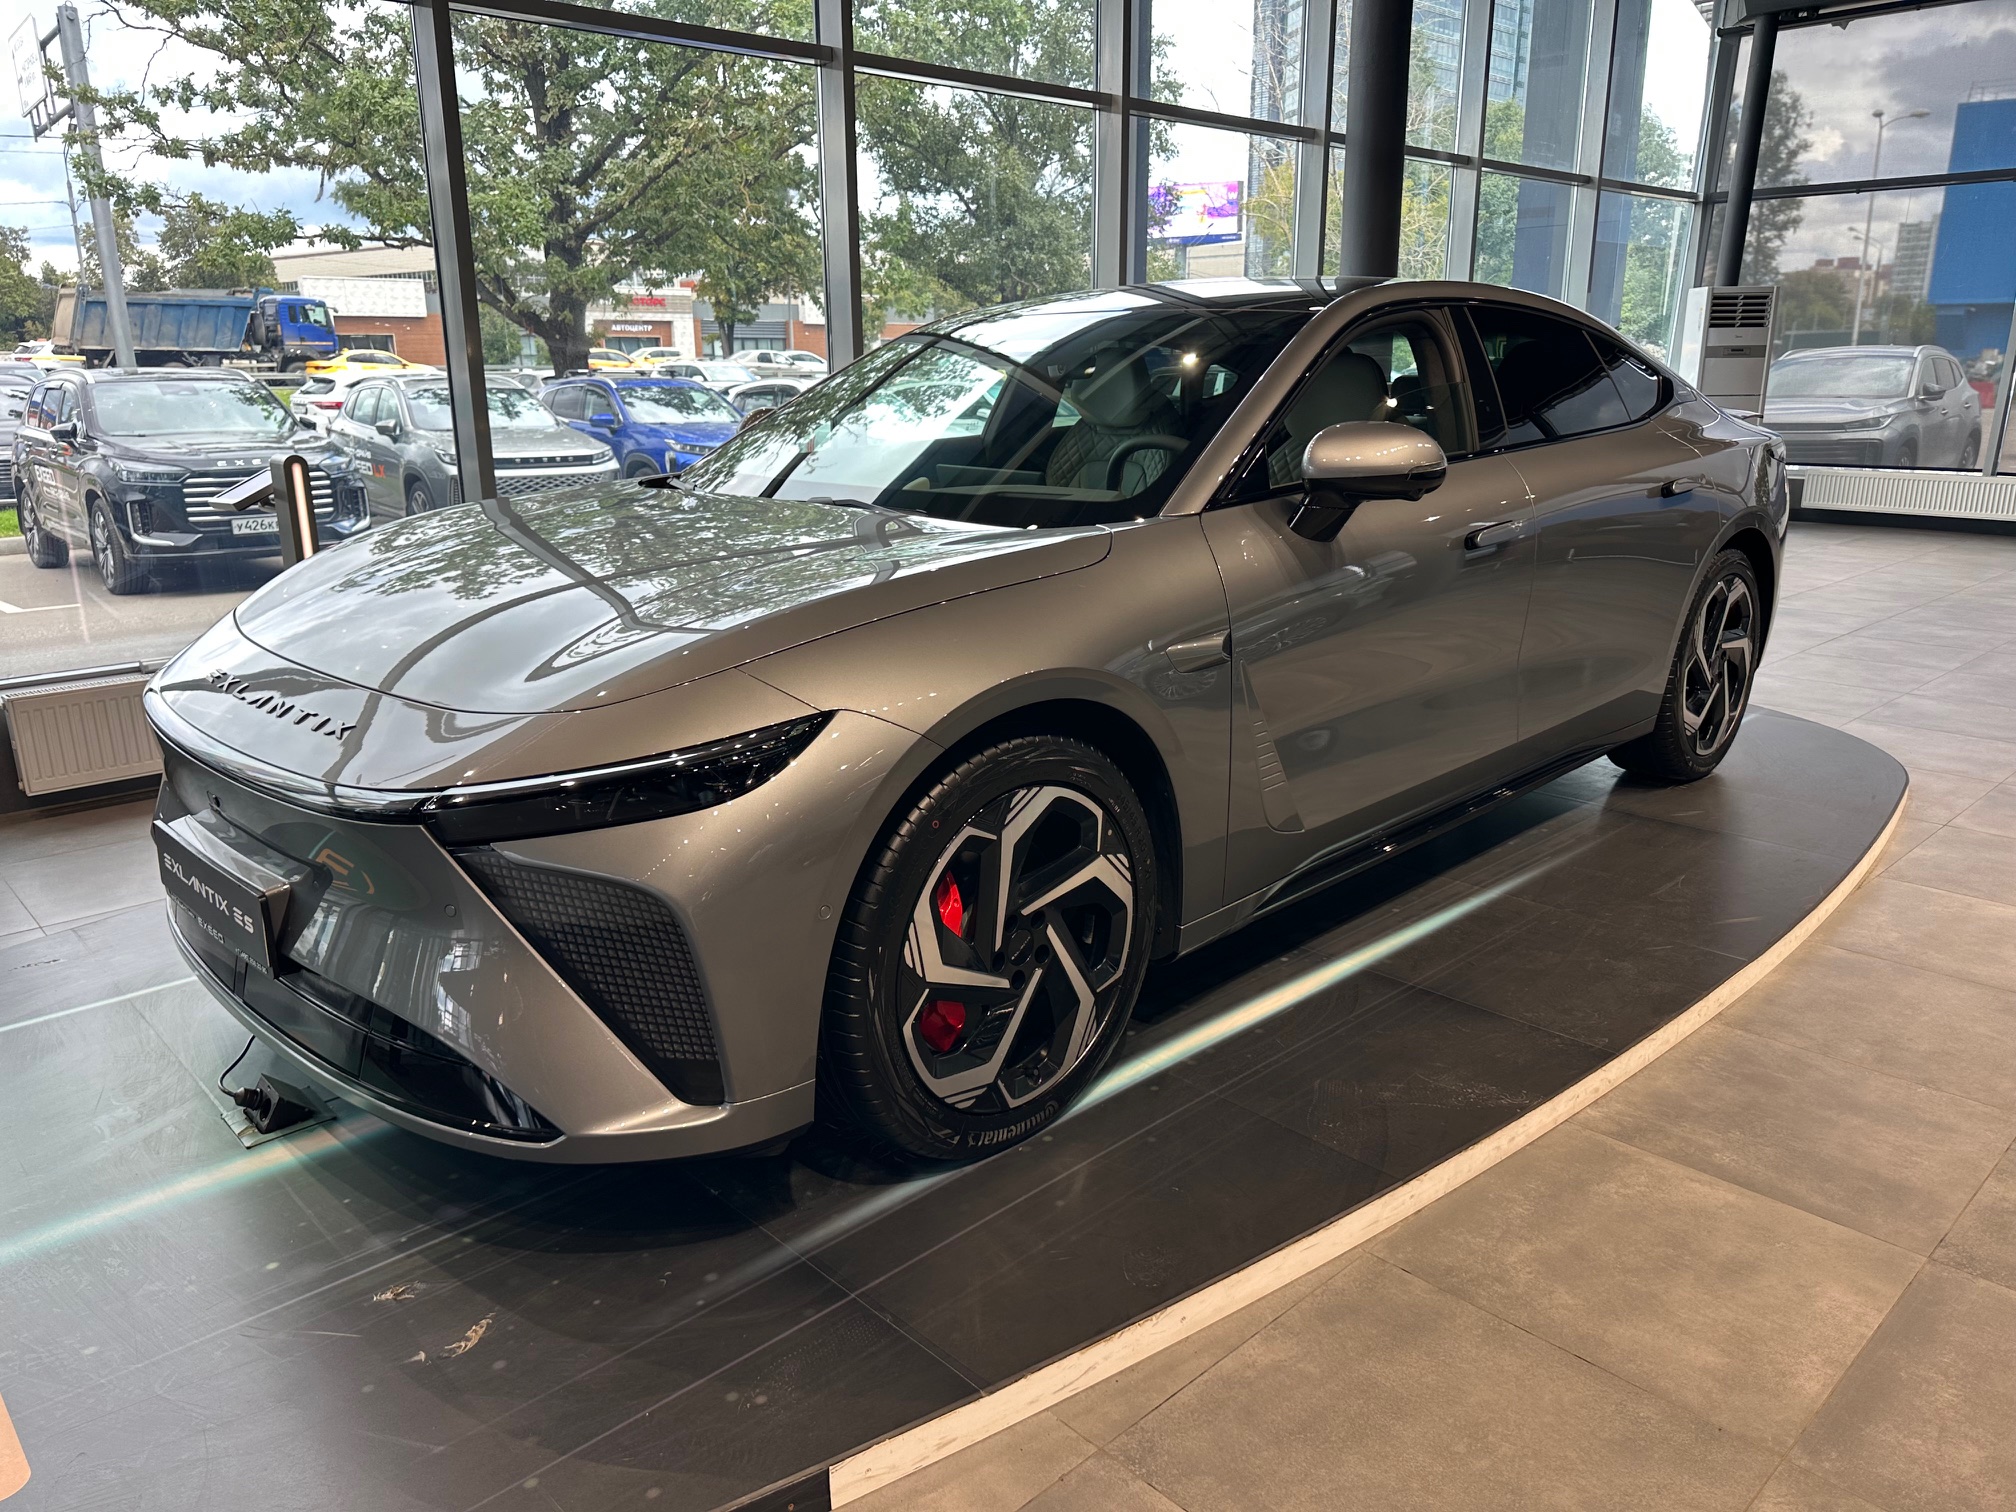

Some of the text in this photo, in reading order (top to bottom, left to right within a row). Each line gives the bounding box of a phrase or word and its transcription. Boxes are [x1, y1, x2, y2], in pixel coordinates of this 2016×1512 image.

[611, 324, 653, 332] АВТОЦЕНТР
[216, 458, 270, 467] EXE
[372, 464, 386, 478] LX
[236, 520, 279, 532] У426К
[205, 668, 357, 741] EXLANTIX
[163, 852, 230, 917] EXLANTIX
[232, 906, 255, 935] ES
[977, 1100, 1060, 1148] Continental
